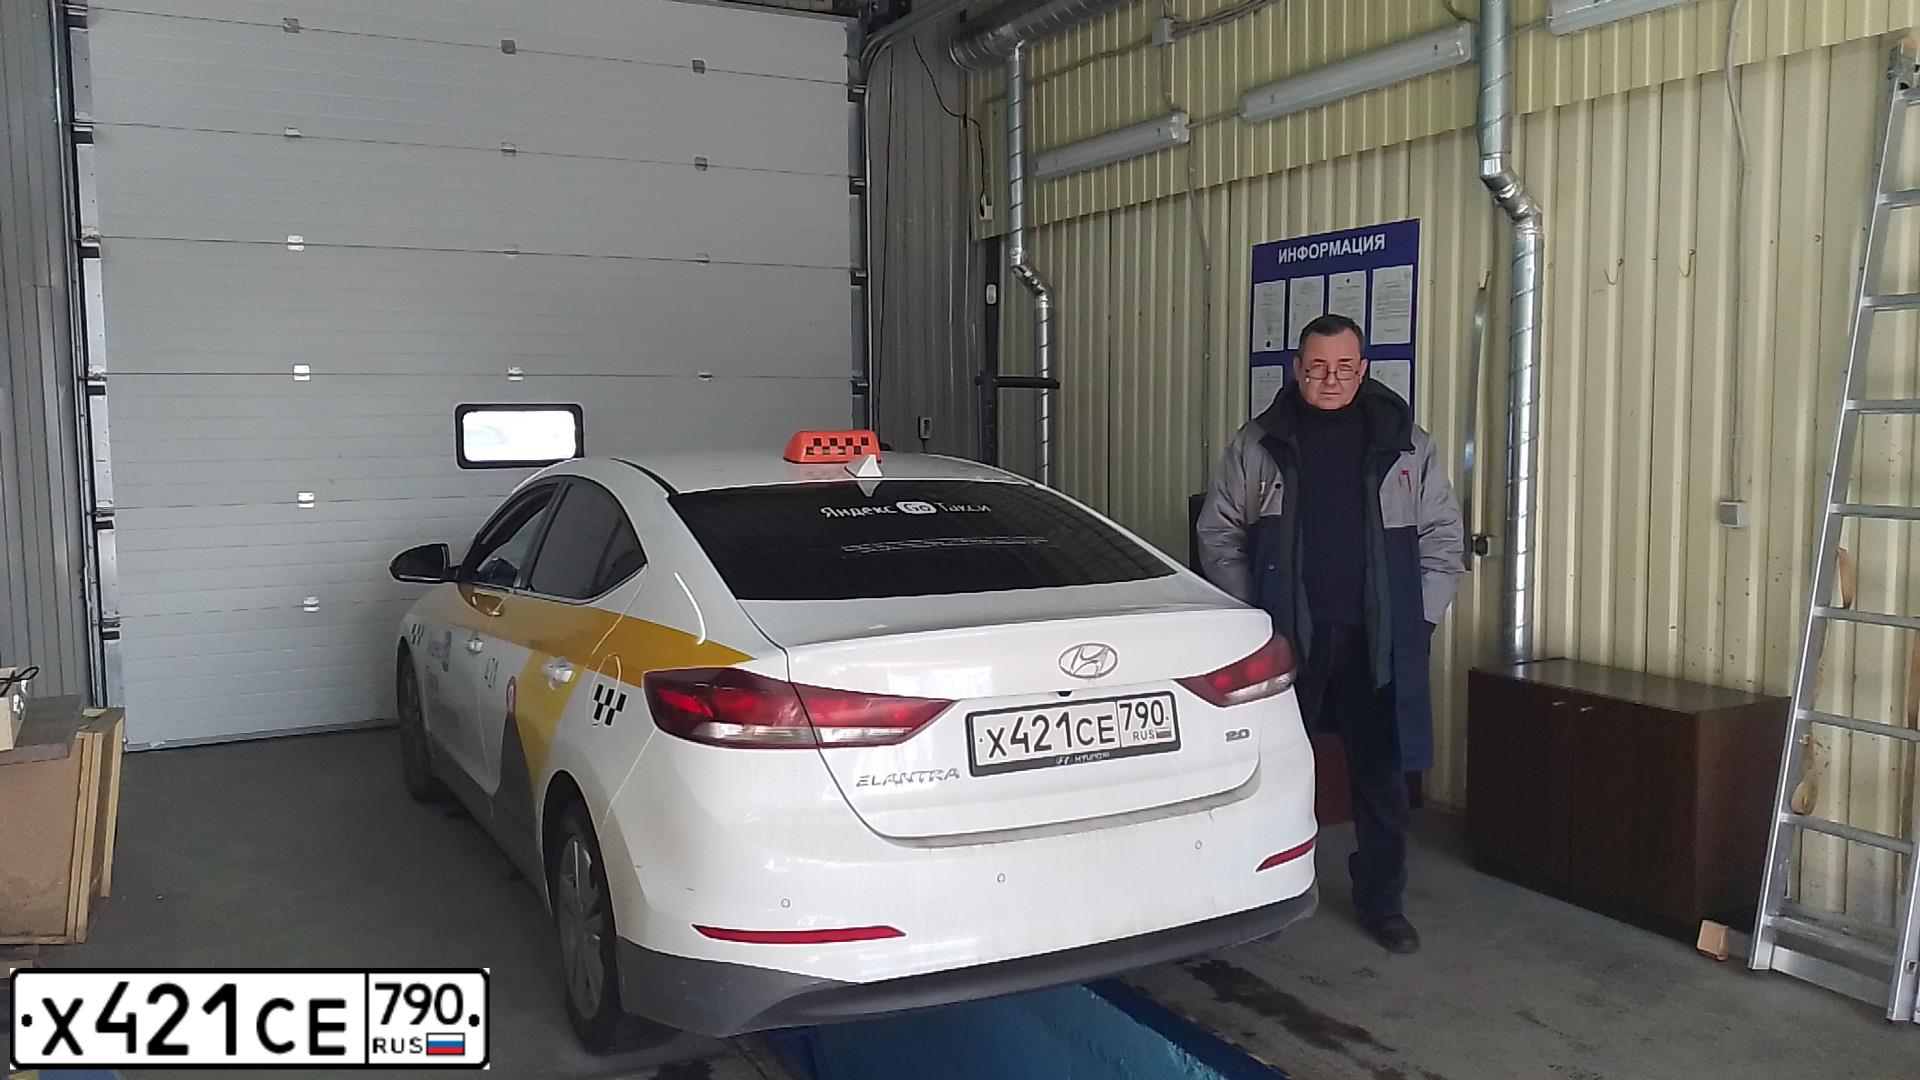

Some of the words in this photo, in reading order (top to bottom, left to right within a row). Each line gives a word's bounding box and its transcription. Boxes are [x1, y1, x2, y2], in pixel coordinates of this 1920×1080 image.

[1278, 235, 1385, 264] ИНФОРМАЦИЯ
[820, 505, 898, 518] Яндекс
[935, 502, 991, 512] Такси
[1120, 699, 1163, 731] 790
[1133, 729, 1155, 741] RUS
[856, 768, 960, 787] ELANTRA
